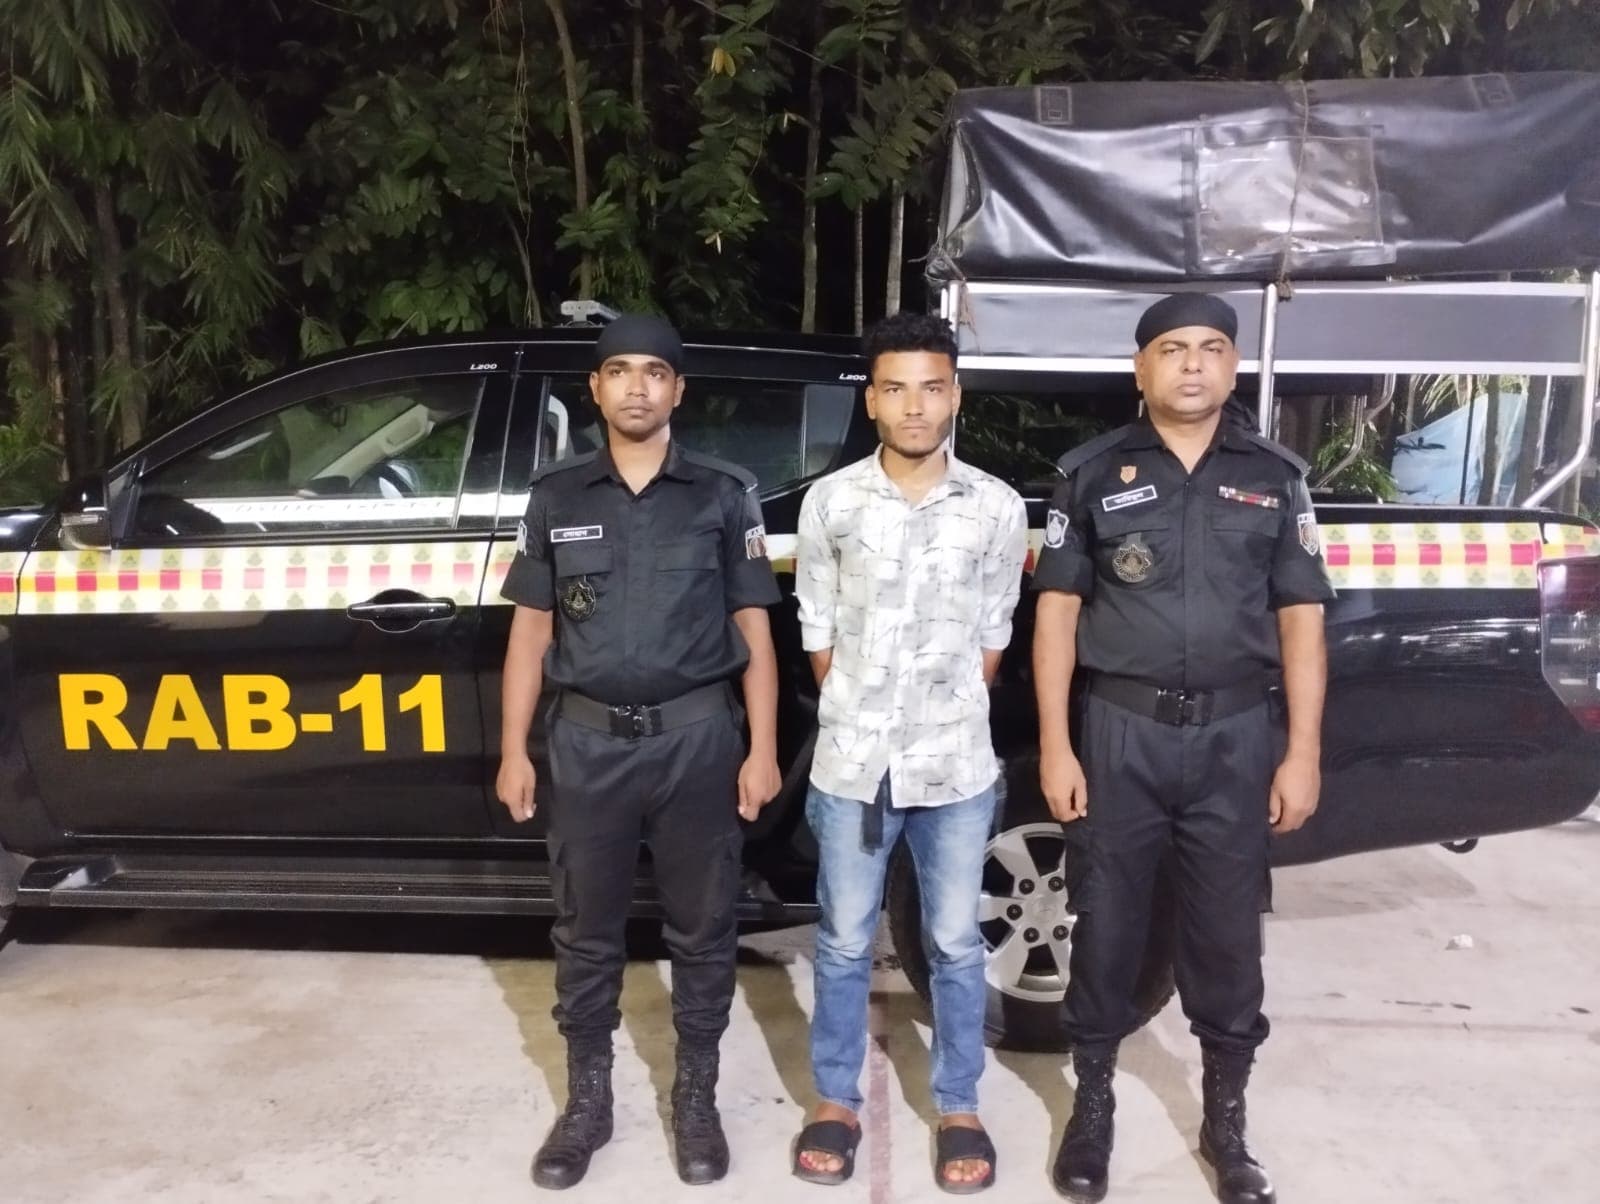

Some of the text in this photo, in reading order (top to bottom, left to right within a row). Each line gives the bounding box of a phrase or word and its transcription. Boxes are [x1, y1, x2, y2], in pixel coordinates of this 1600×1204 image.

[469, 363, 498, 371] L200
[838, 372, 867, 381] L200
[58, 673, 446, 753] RAB-11
